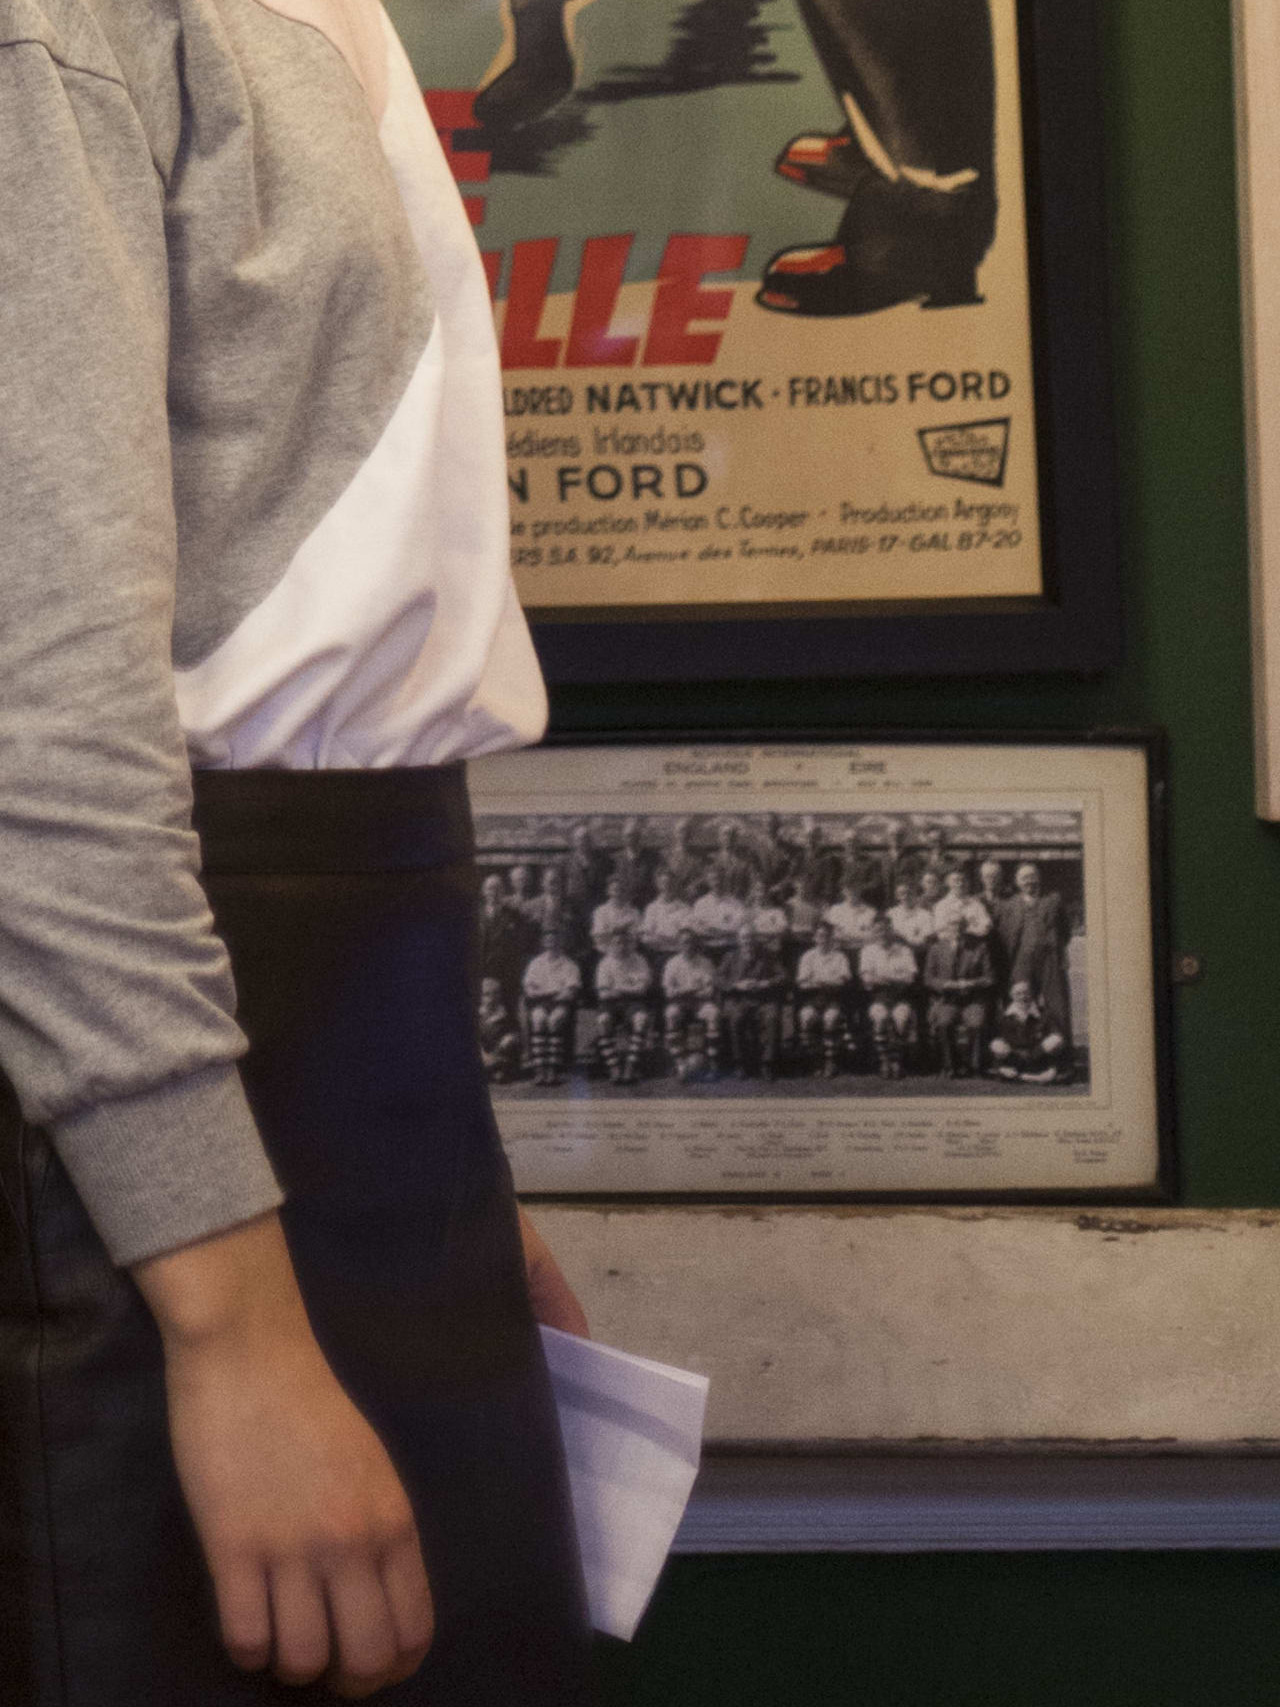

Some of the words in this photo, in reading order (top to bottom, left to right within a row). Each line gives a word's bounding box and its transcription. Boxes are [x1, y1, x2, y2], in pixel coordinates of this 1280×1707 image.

[585, 377, 766, 415] NATWICK
[788, 373, 900, 408] FRANCIS
[906, 370, 1012, 404] FORD
[556, 462, 710, 503] FORD
